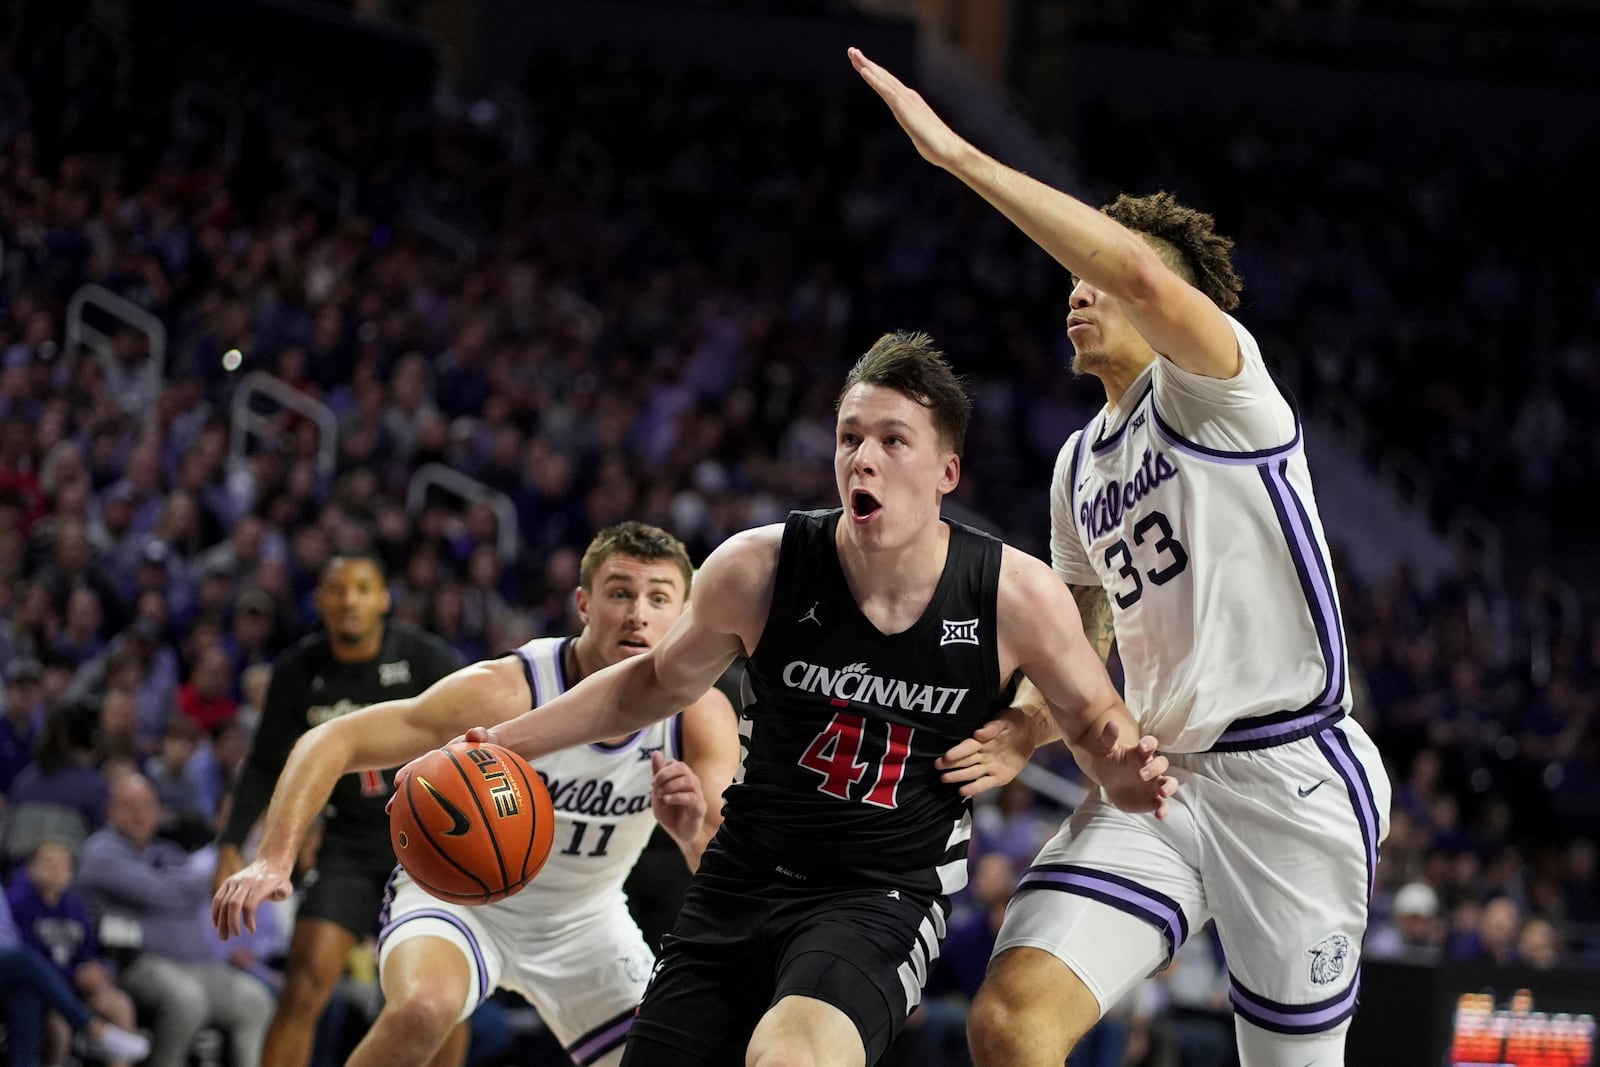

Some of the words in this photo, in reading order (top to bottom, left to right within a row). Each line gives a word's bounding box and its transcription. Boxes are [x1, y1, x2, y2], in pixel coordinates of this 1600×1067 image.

[1080, 445, 1179, 546] Wilcats
[1104, 511, 1188, 610] 33
[939, 618, 979, 646] XII
[782, 660, 969, 714] CINCINNATI
[466, 748, 519, 818] ELITE
[798, 698, 915, 809] 41
[537, 770, 653, 816] Wildca
[561, 820, 616, 857] 11
